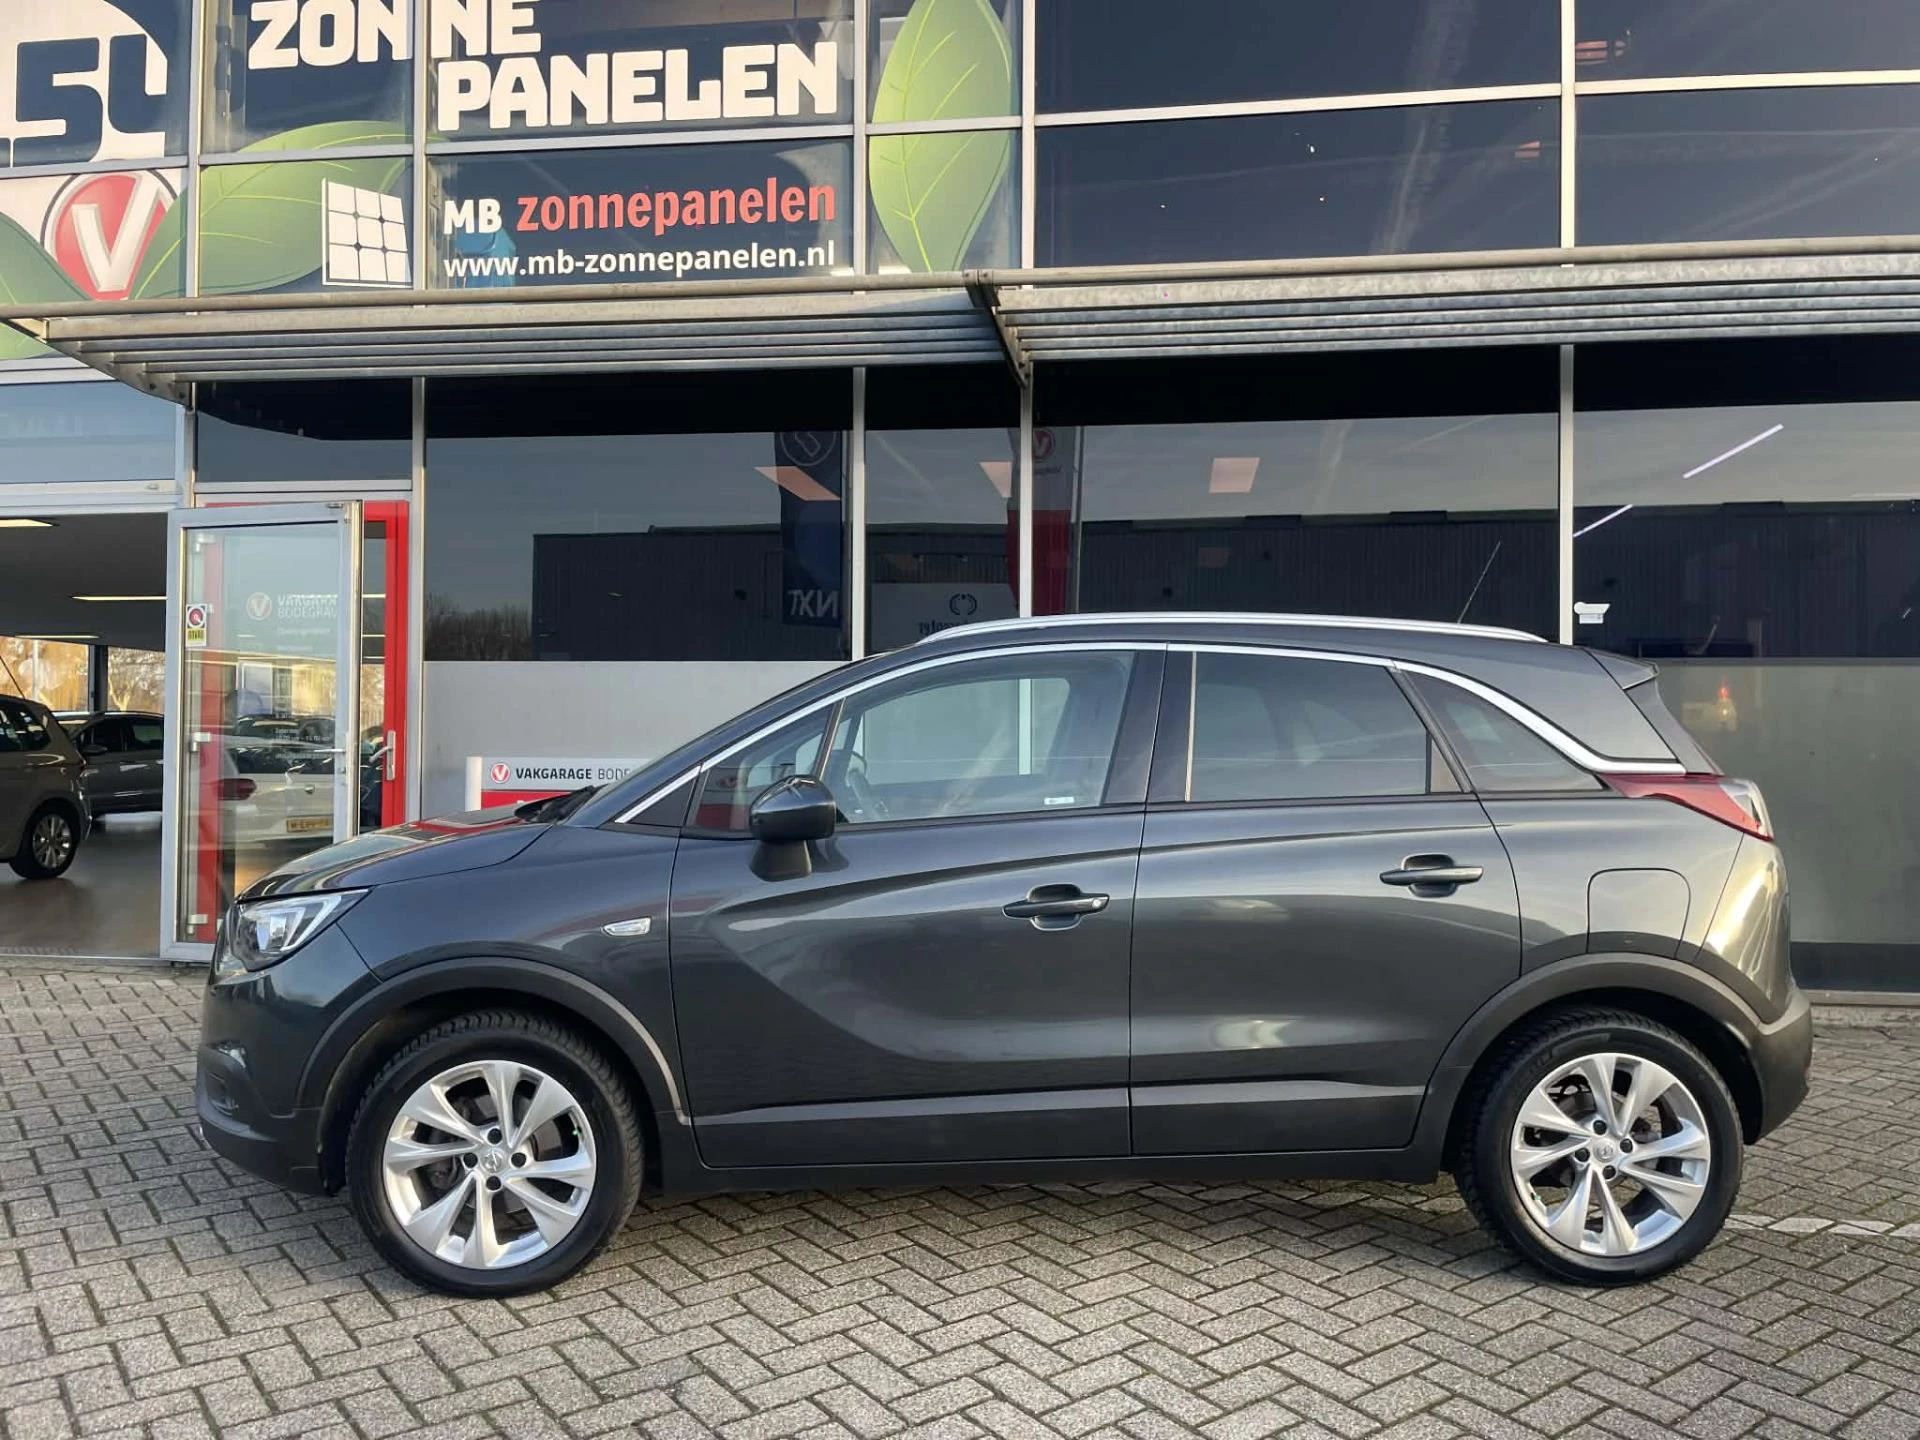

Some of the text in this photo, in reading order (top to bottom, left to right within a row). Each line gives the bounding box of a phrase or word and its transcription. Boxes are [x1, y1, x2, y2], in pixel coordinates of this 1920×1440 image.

[437, 41, 837, 131] PANELEN
[443, 176, 836, 237] MB zonnepanelen
[443, 240, 836, 279] www.mb-zonnepanelen.nl
[515, 767, 592, 780] VAKGARAGE
